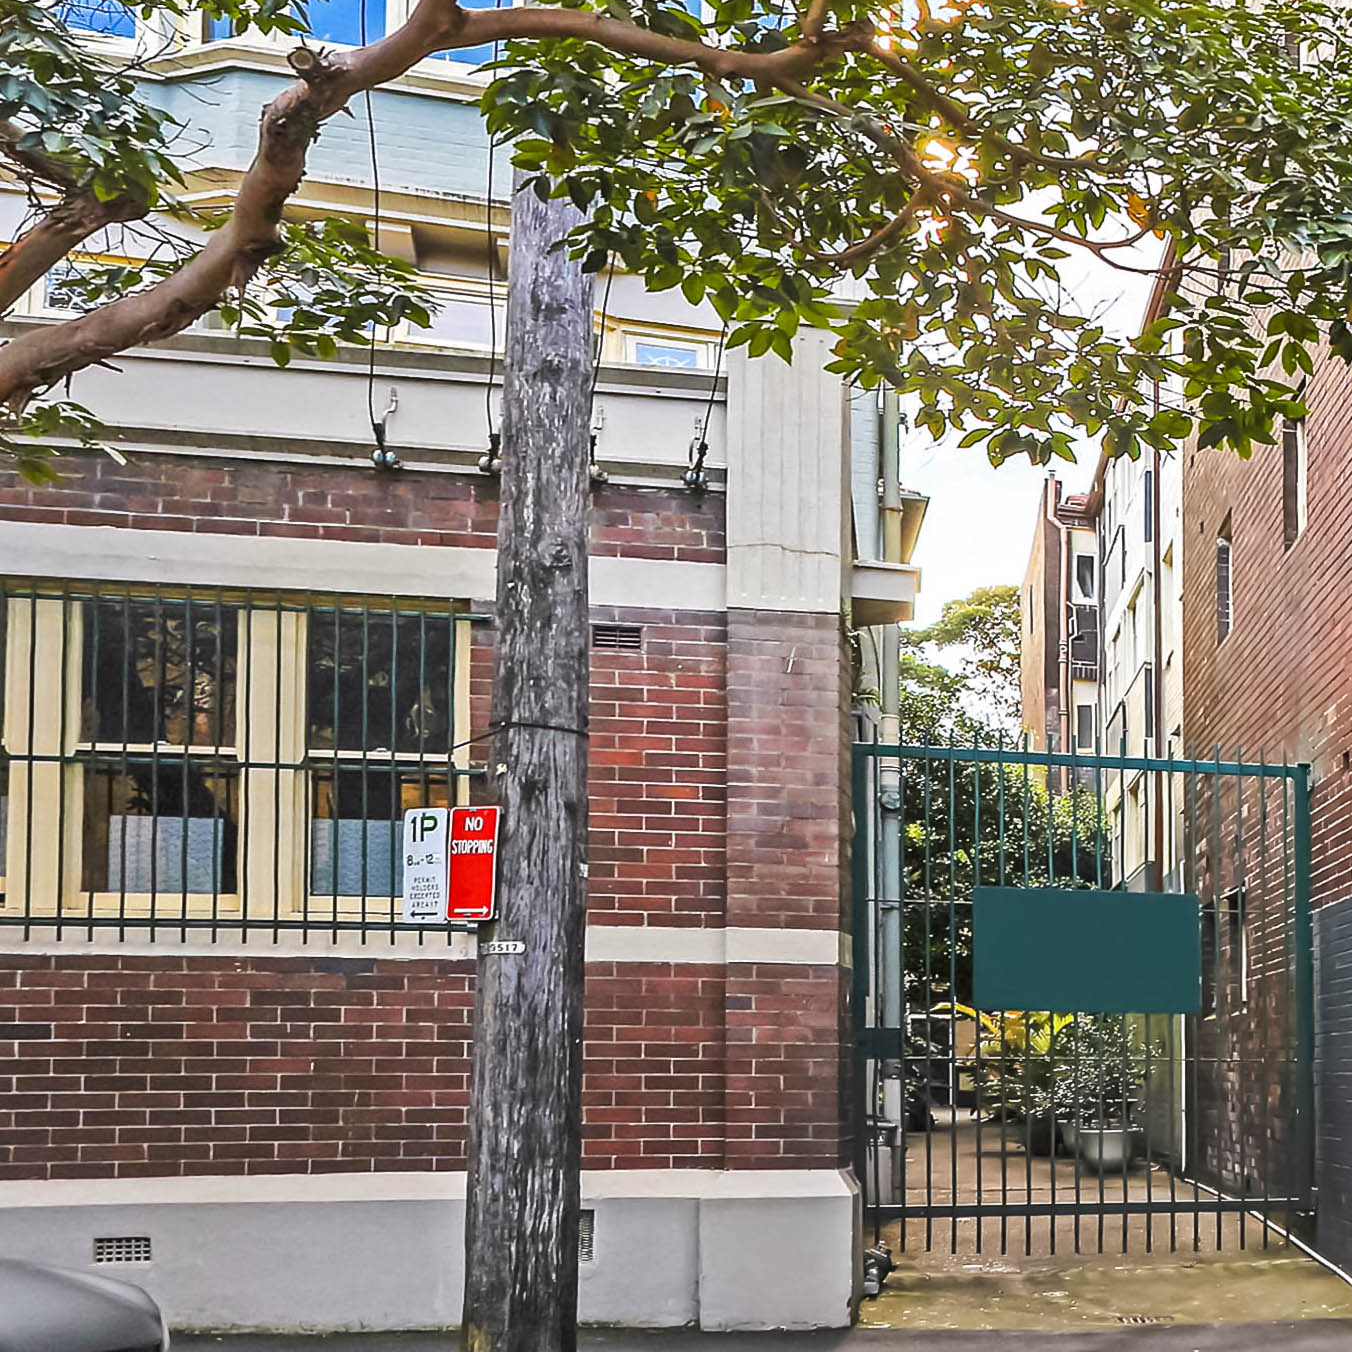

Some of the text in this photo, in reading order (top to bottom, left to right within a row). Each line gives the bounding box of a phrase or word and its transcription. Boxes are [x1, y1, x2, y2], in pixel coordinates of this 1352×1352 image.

[410, 814, 438, 842] 1P
[464, 817, 484, 831] NO
[451, 839, 493, 855] STOPPING
